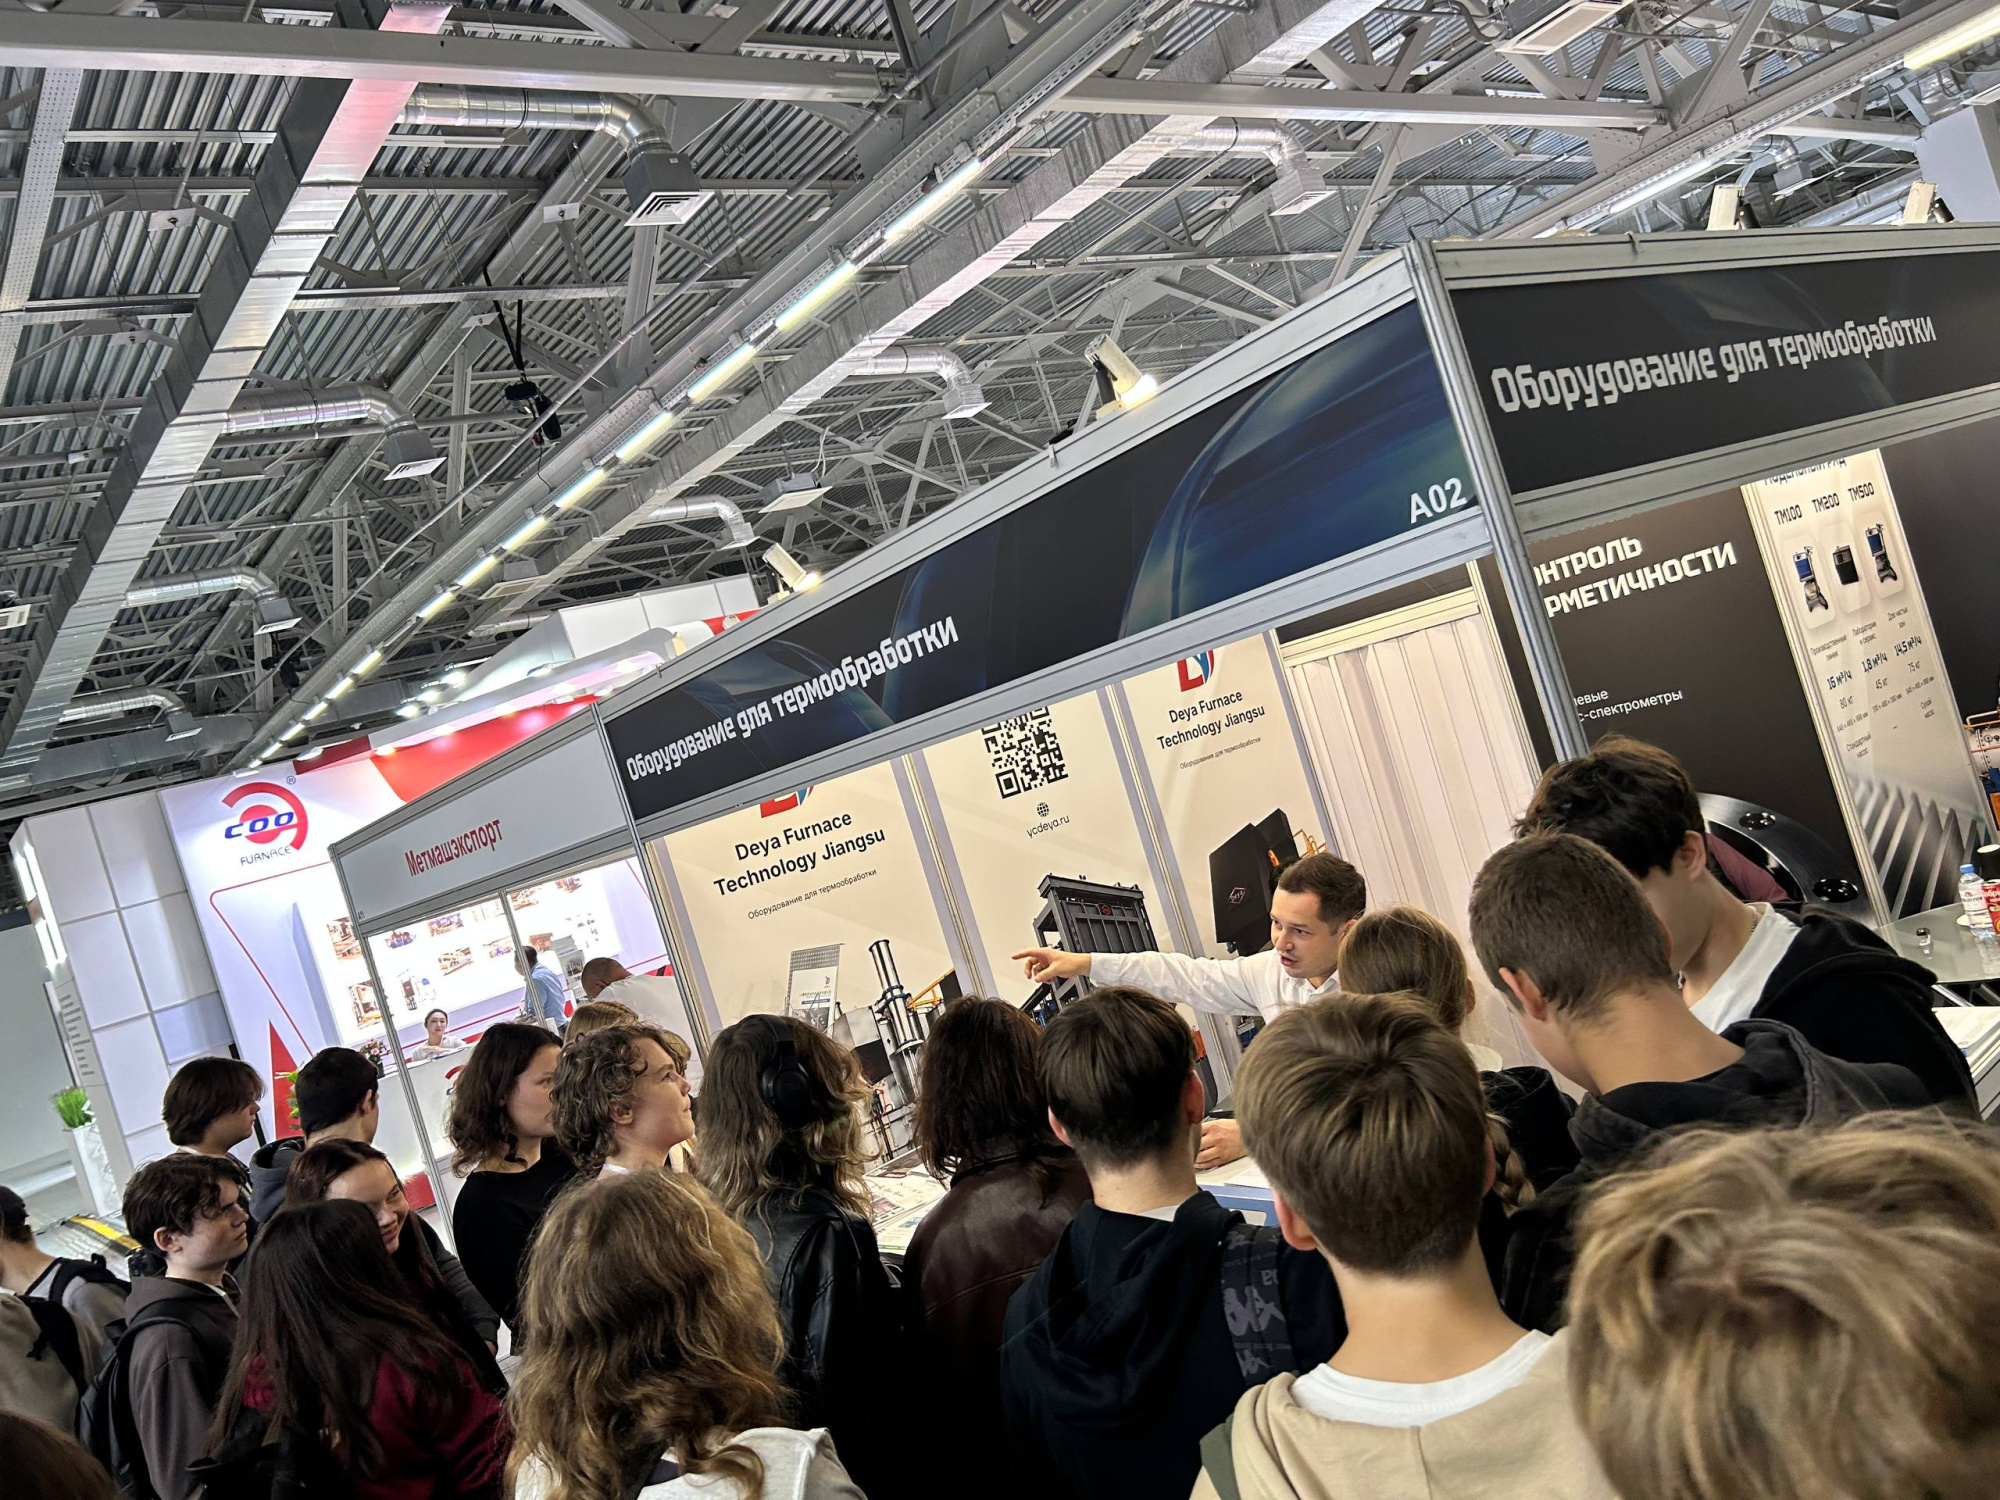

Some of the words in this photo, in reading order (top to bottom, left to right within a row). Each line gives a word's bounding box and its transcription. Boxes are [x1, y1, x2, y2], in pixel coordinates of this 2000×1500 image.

[1491, 347, 1717, 412] Оборудование
[1719, 342, 1768, 382] для
[1767, 315, 1936, 370] термообработки
[1409, 477, 1466, 524] A02
[1774, 505, 1802, 525] TM100
[1812, 493, 1840, 513] TM200
[1848, 482, 1875, 501] TM500
[1533, 537, 1642, 587] НТРОЛЬ
[1544, 542, 1737, 618] РМЕТИЧНОСТИ
[626, 716, 736, 781] Оборудование
[737, 700, 773, 739] для
[771, 615, 959, 718] термообработки
[1169, 706, 1198, 724] Deya
[1199, 690, 1243, 715] Furnace
[1578, 690, 1683, 722] с-спектрометры
[1156, 721, 1222, 750] Technology
[1224, 705, 1266, 730] Jiangsu
[405, 819, 503, 877] Метмашэкспорт
[735, 836, 781, 861] Deya
[783, 813, 853, 845] Furnace
[1026, 815, 1070, 839] ycdeya.ru
[240, 845, 291, 866] FURNACE
[713, 851, 817, 896] Technology
[822, 829, 885, 861] Jiangsu
[748, 895, 803, 920] Оборудование
[804, 889, 817, 901] для
[818, 868, 877, 895] термообработки
